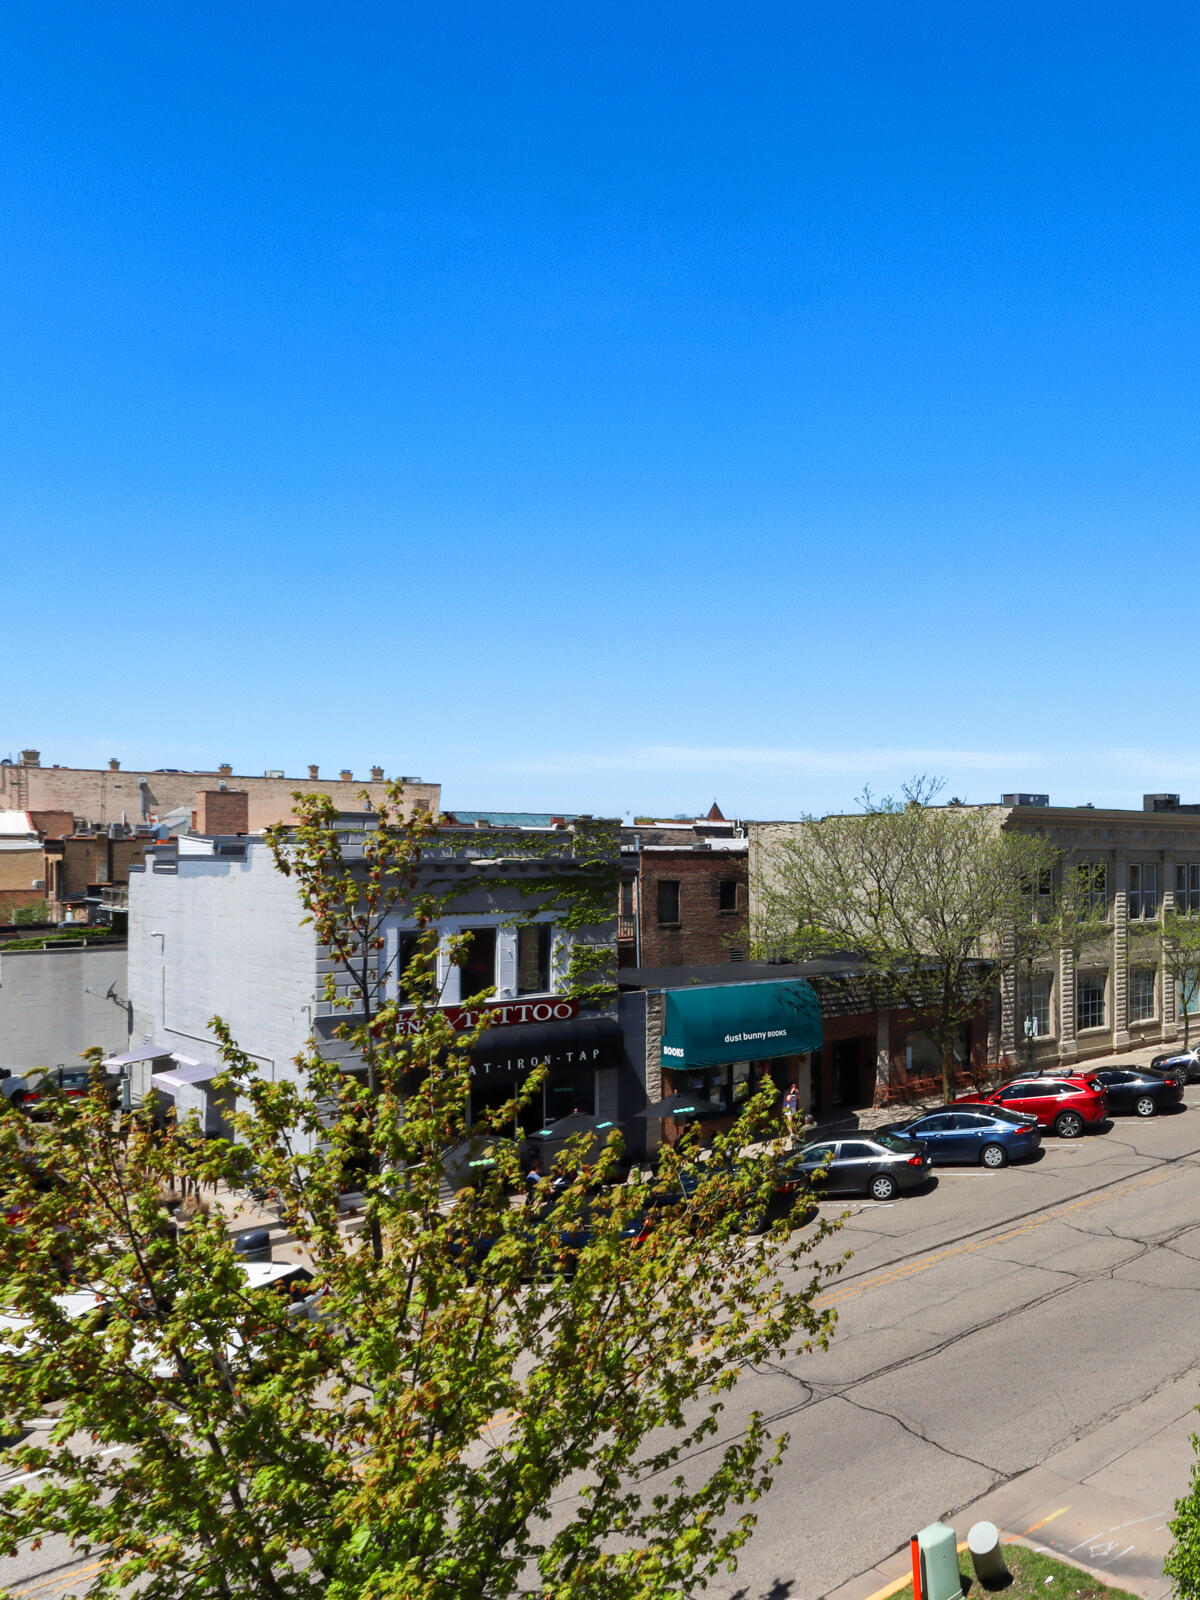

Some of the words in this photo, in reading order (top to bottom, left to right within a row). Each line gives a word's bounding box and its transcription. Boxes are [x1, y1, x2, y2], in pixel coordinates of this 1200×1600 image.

[724, 1034, 742, 1043] dust
[743, 1032, 767, 1041] bunny
[767, 1029, 787, 1038] BOOKS
[663, 1045, 685, 1058] BOOKS
[439, 1049, 600, 1081] FAT-IRON-TAP
